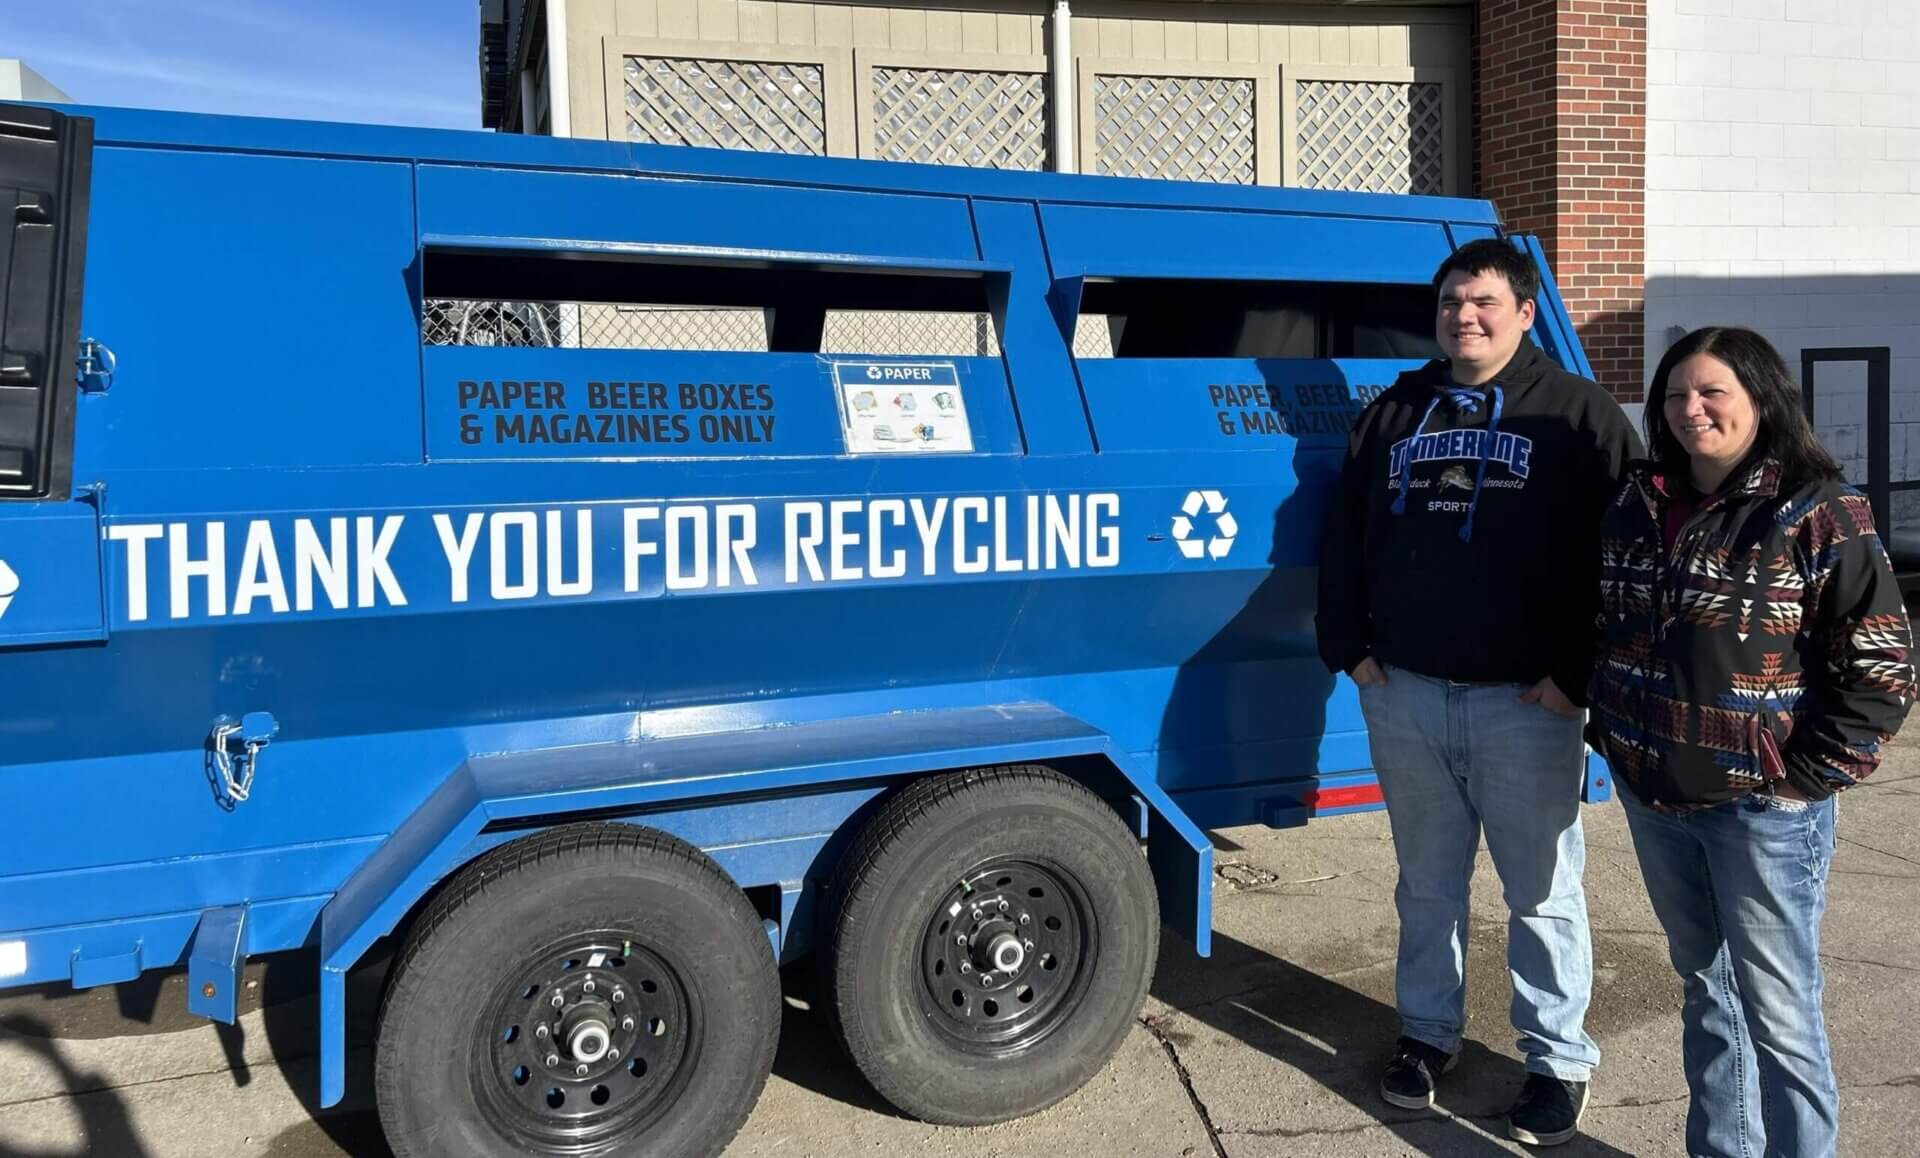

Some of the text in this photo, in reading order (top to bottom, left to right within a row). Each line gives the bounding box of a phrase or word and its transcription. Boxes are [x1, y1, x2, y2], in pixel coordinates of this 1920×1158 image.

[885, 368, 931, 380] PAPER
[457, 381, 775, 411] PAPER BEER BOXES
[1295, 384, 1352, 407] BEER
[460, 413, 776, 444] & MAGAZINES ONLY
[1217, 411, 1236, 435] &
[1481, 477, 1525, 489] innesota
[1428, 501, 1474, 512] SPORTS
[103, 492, 1120, 621] THANK YOU FOR RECYCLING
